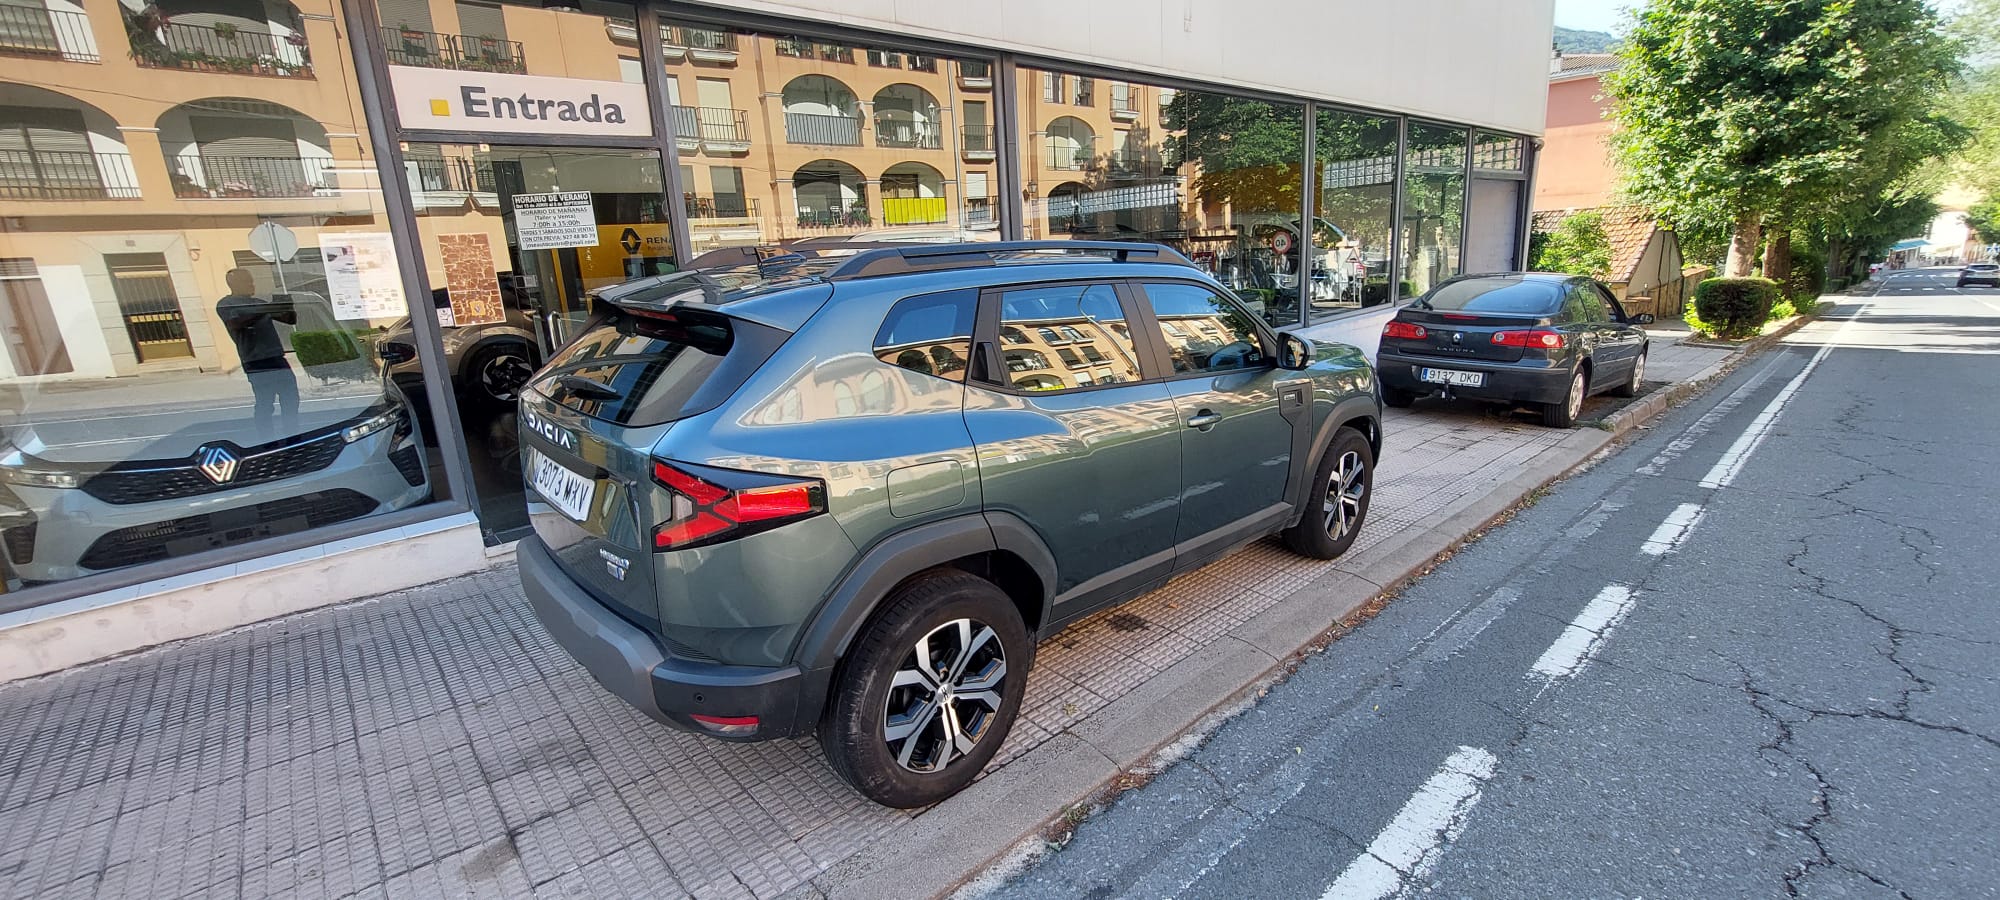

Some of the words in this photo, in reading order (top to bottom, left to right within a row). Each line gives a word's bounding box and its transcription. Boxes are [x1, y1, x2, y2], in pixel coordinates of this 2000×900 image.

[460, 86, 625, 124] Entrada
[548, 194, 558, 202] DE
[559, 193, 588, 201] VERANO
[558, 206, 588, 214] MAÑANAS
[535, 214, 552, 222] (Taller
[533, 221, 551, 229] 7:00h
[1429, 370, 1455, 381] 9137
[1460, 372, 1480, 384] DKD
[528, 413, 571, 450] DACIA
[539, 457, 565, 498] 3073
[563, 474, 589, 513] MXV
